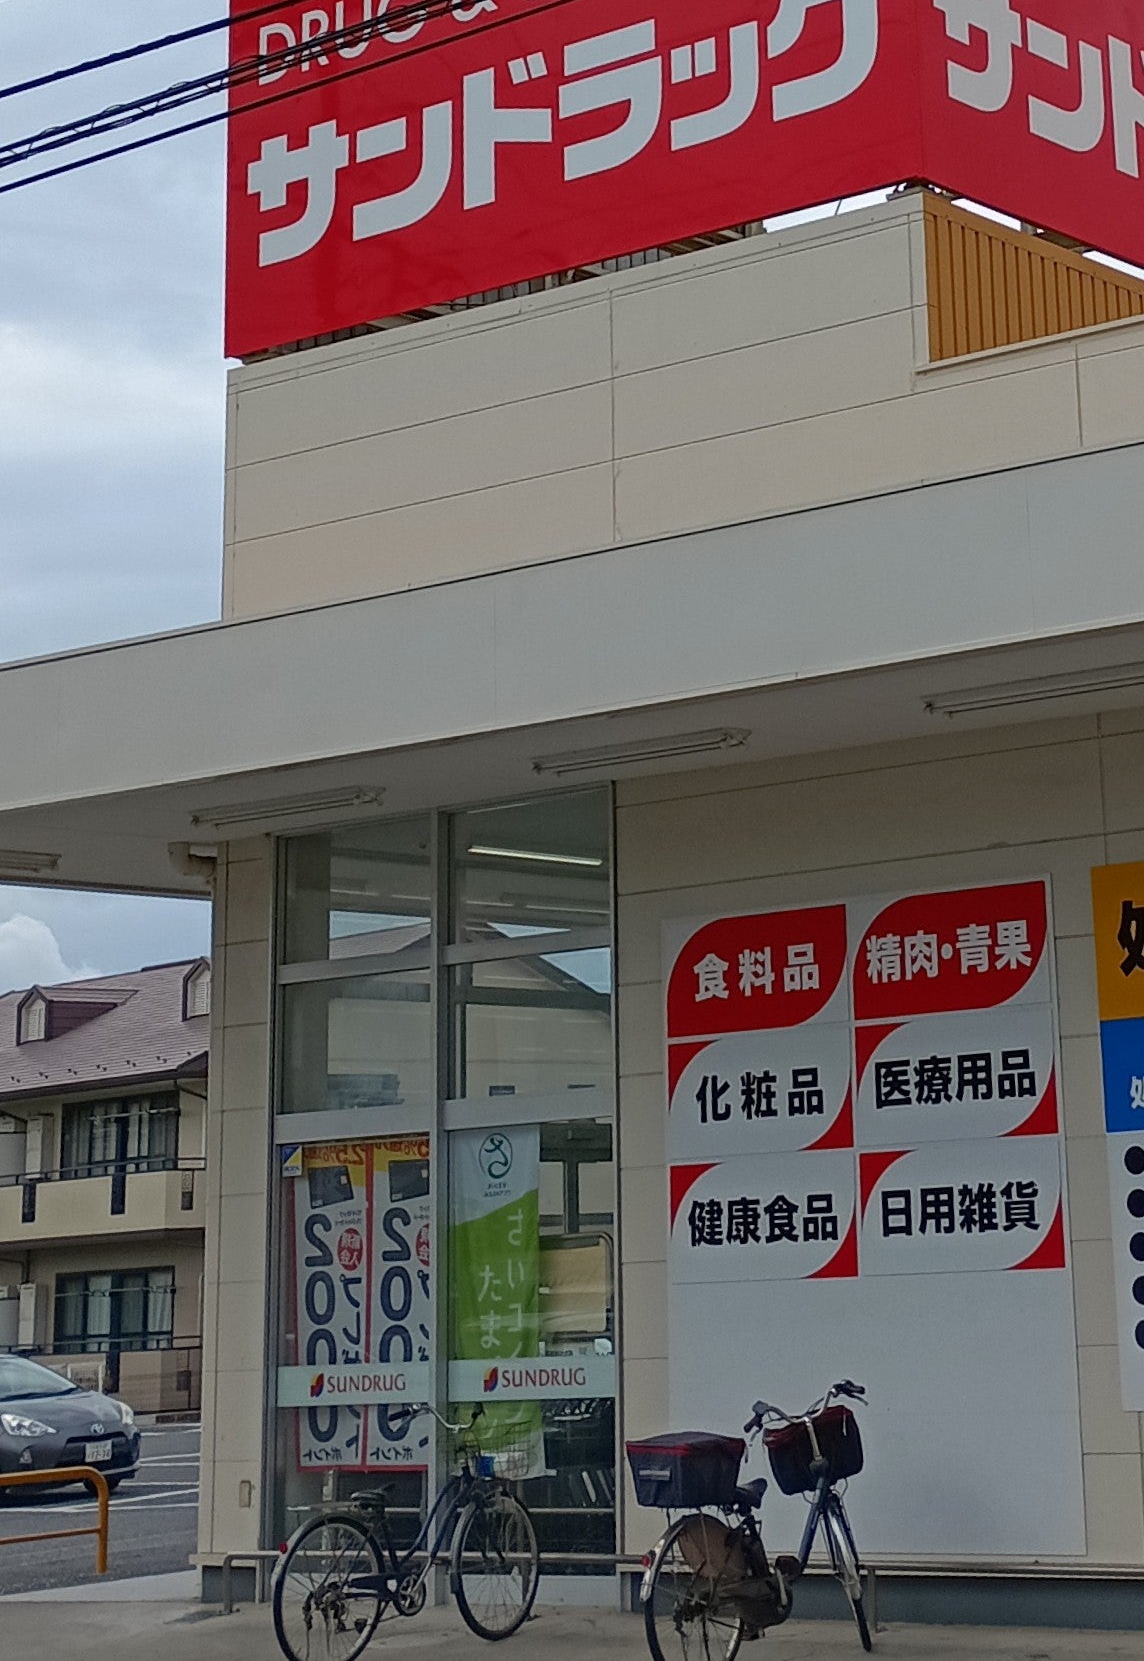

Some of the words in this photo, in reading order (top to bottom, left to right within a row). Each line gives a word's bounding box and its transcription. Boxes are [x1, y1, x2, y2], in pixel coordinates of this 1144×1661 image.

[693, 942, 821, 1002] 食料品
[866, 919, 1033, 985] 精肉・青果
[695, 1067, 825, 1124] 化粧品
[873, 1048, 1037, 1110] 医療用品
[687, 1193, 839, 1247] 健康食品
[880, 1180, 1041, 1238] 日用雑貨
[327, 1373, 406, 1394] SUNDRUG
[502, 1367, 587, 1389] SUNDRUG
